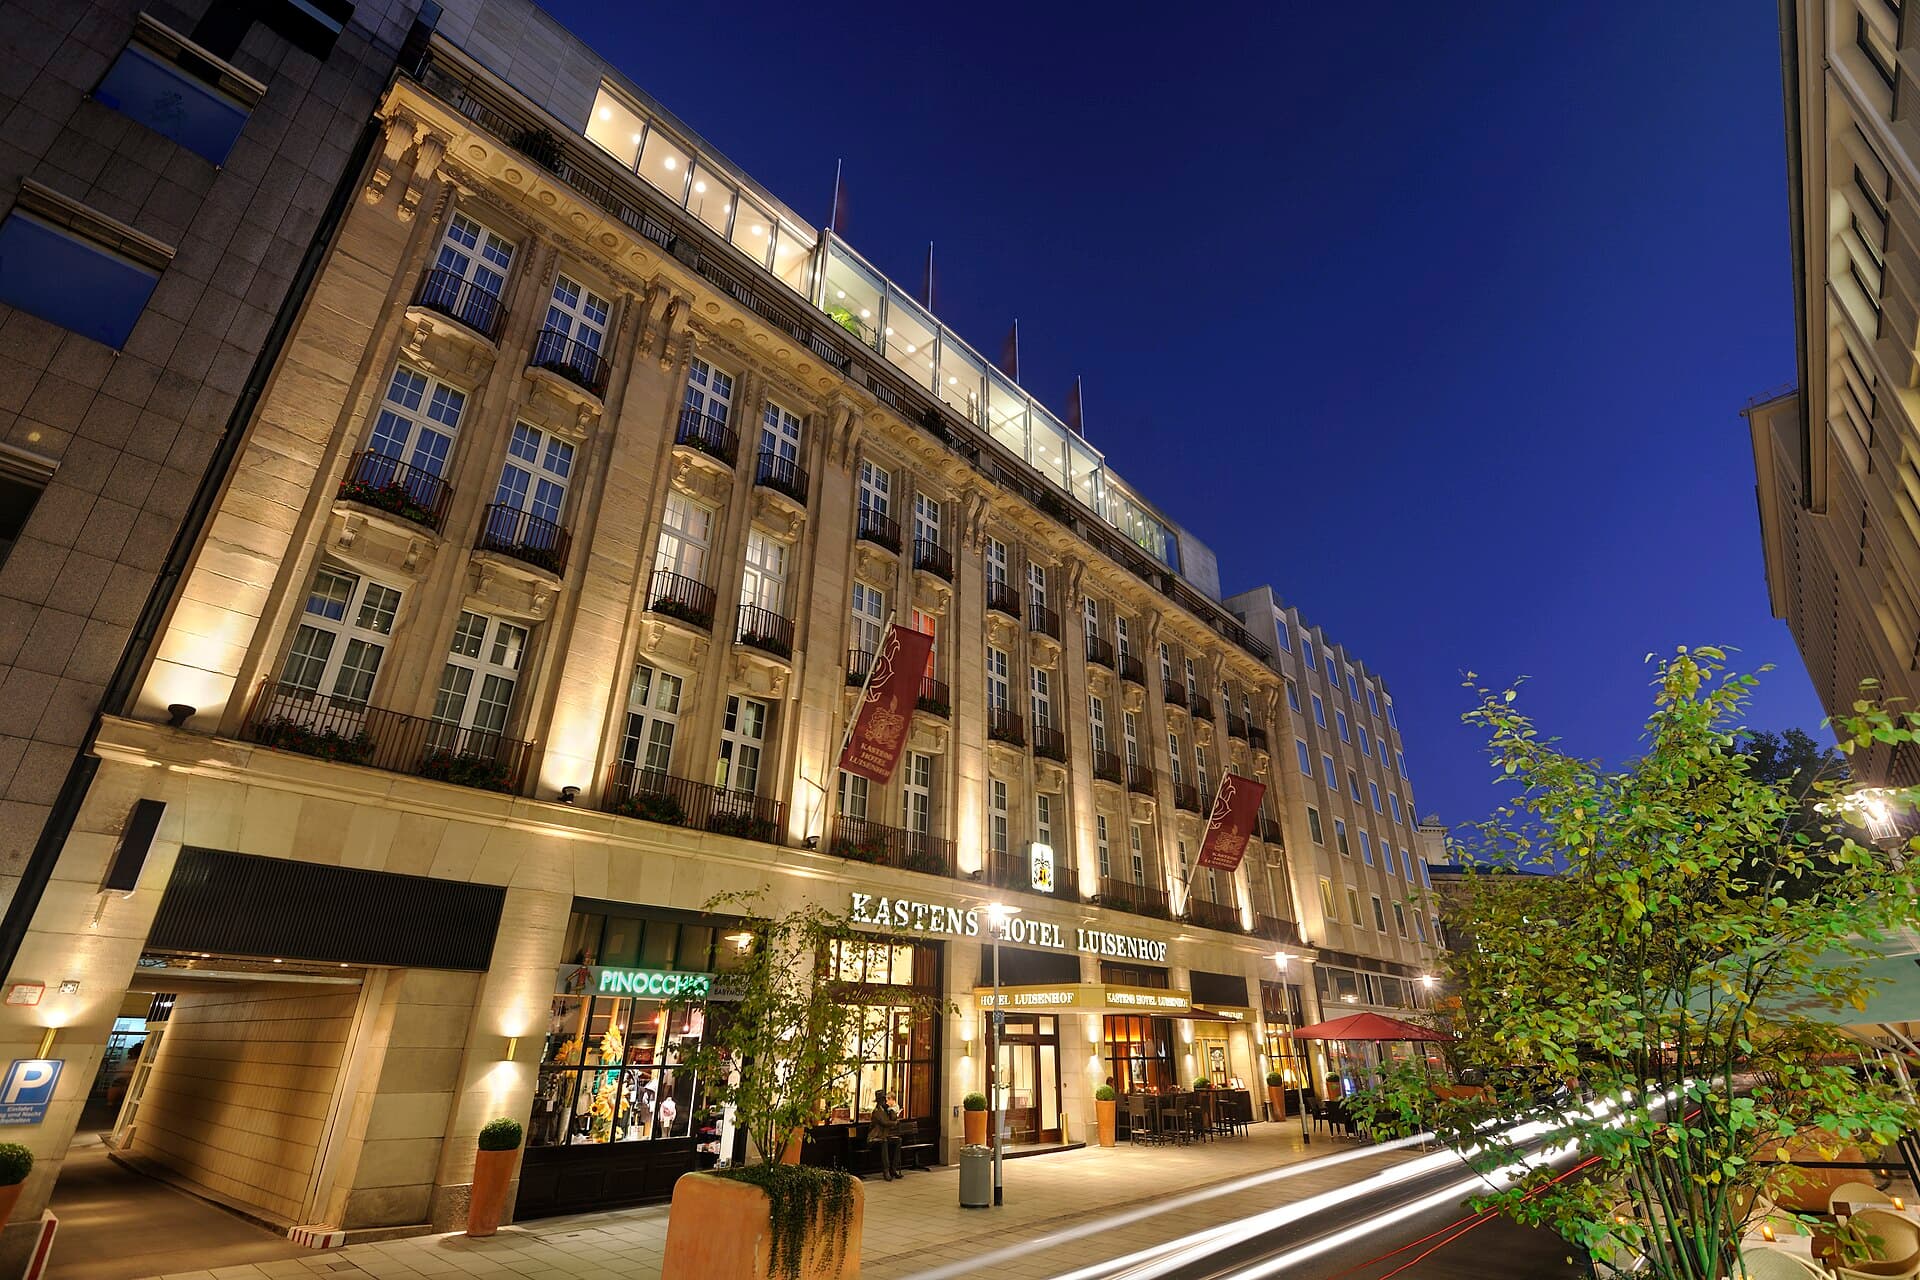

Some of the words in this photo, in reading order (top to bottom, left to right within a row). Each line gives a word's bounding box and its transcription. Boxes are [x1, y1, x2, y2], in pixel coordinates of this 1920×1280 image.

[861, 751, 886, 766] HOTEL
[850, 892, 979, 937] KASTENS
[997, 915, 1065, 948] HOTEL
[1077, 928, 1167, 962] LUISENHOF
[600, 970, 710, 996] PINOCCHIO
[981, 994, 1011, 1006] HOEL
[1014, 992, 1075, 1005] LUISENHOF
[1106, 992, 1135, 1005] KASTENS
[1136, 994, 1157, 1006] HOTEL
[5, 1062, 53, 1104] P
